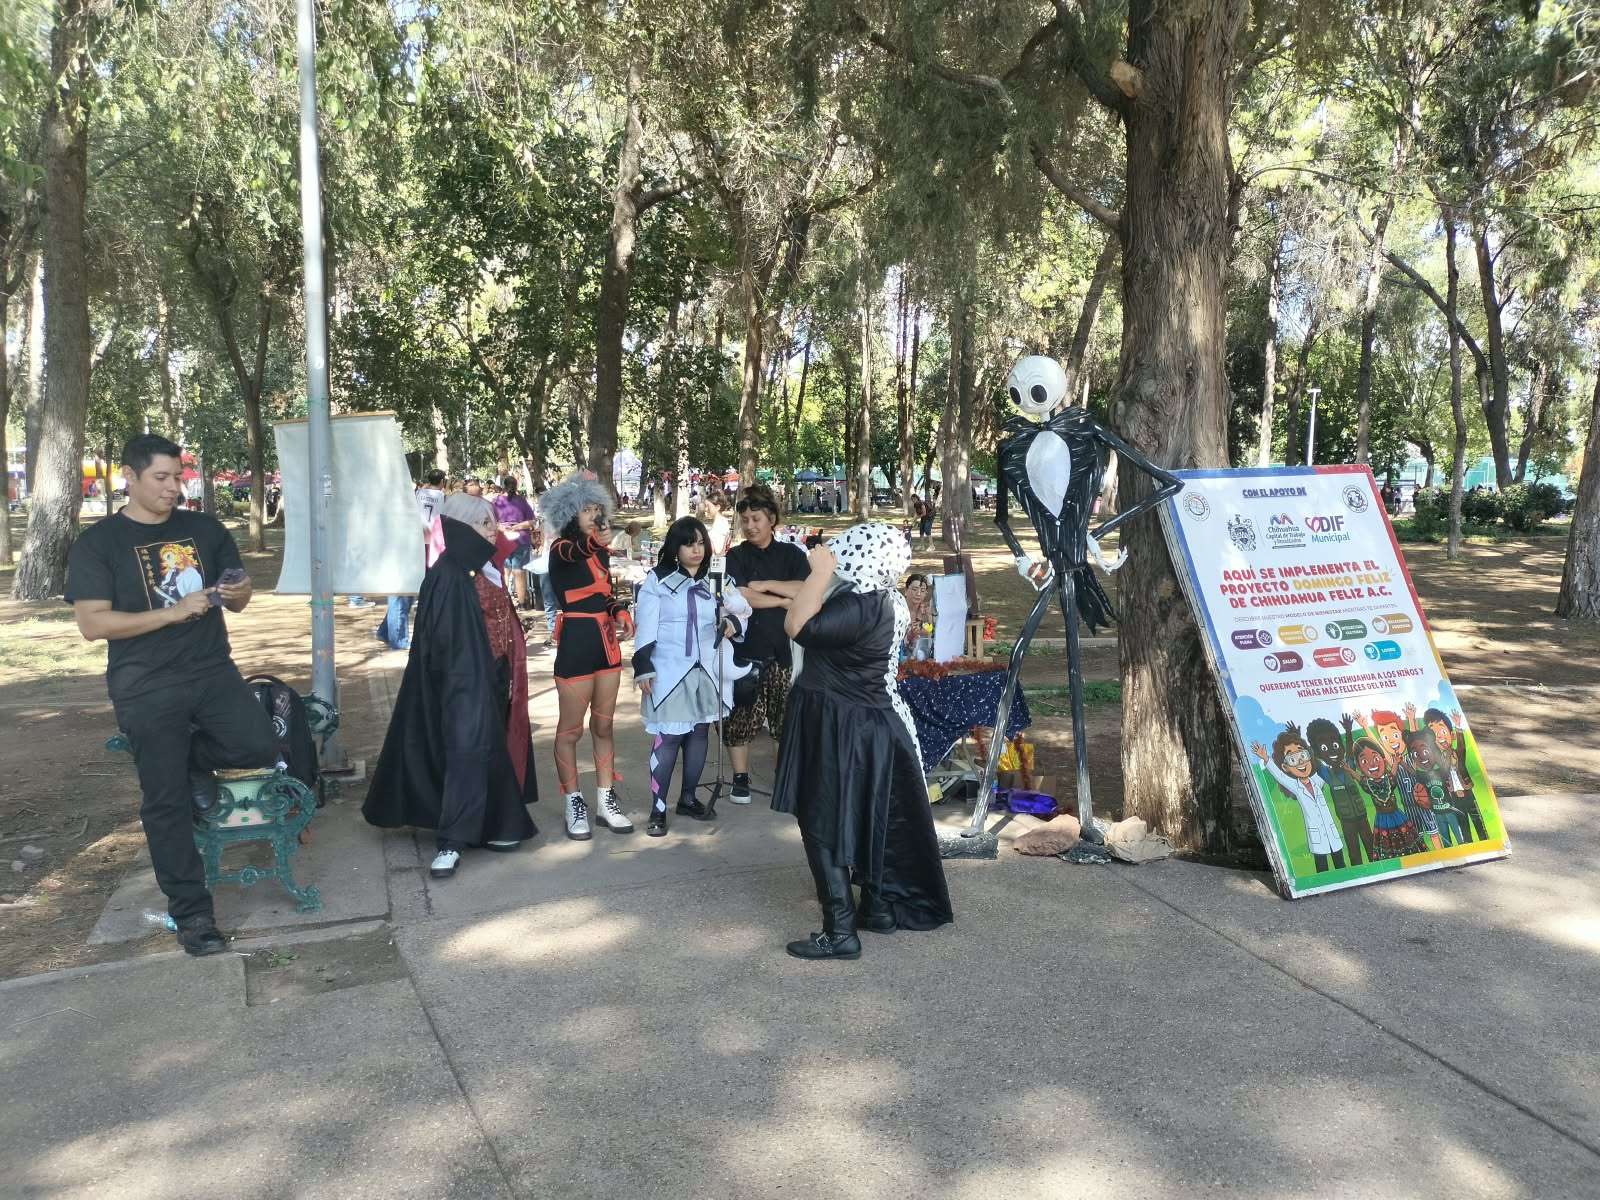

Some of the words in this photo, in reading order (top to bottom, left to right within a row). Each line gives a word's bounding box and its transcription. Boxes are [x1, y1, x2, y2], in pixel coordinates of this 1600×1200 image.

[1242, 488, 1259, 498] CON
[1260, 488, 1268, 497] EL
[1269, 487, 1296, 497] APOYO
[1296, 486, 1307, 496] DE
[424, 504, 433, 521] 7
[1319, 515, 1344, 532] DIF
[1311, 532, 1351, 543] Municipal
[1223, 564, 1256, 581] AQUÍ
[1259, 568, 1276, 579] SE
[1278, 561, 1361, 578] IMPLEMENTA
[1363, 559, 1380, 571] EL
[1219, 580, 1290, 596] PROYECTO
[1293, 575, 1353, 591] DOMINGO
[1356, 571, 1392, 585] FELIZ
[1229, 597, 1248, 609] DE
[1250, 591, 1327, 608] CHIHUAHUA
[1328, 587, 1365, 601] FELIZ
[1367, 585, 1393, 598] A.C.
[1259, 681, 1300, 693] QUEREMOS
[1301, 679, 1324, 687] TENER
[1324, 677, 1334, 685] EN
[1334, 672, 1376, 684] CHIHUAHUA
[1383, 670, 1396, 678] LOS
[1396, 667, 1418, 677] NIÑOS
[1418, 667, 1424, 675] Y
[1297, 688, 1321, 698] NIÑAS
[1339, 683, 1366, 693] FELICES
[1366, 682, 1379, 690] DEL
